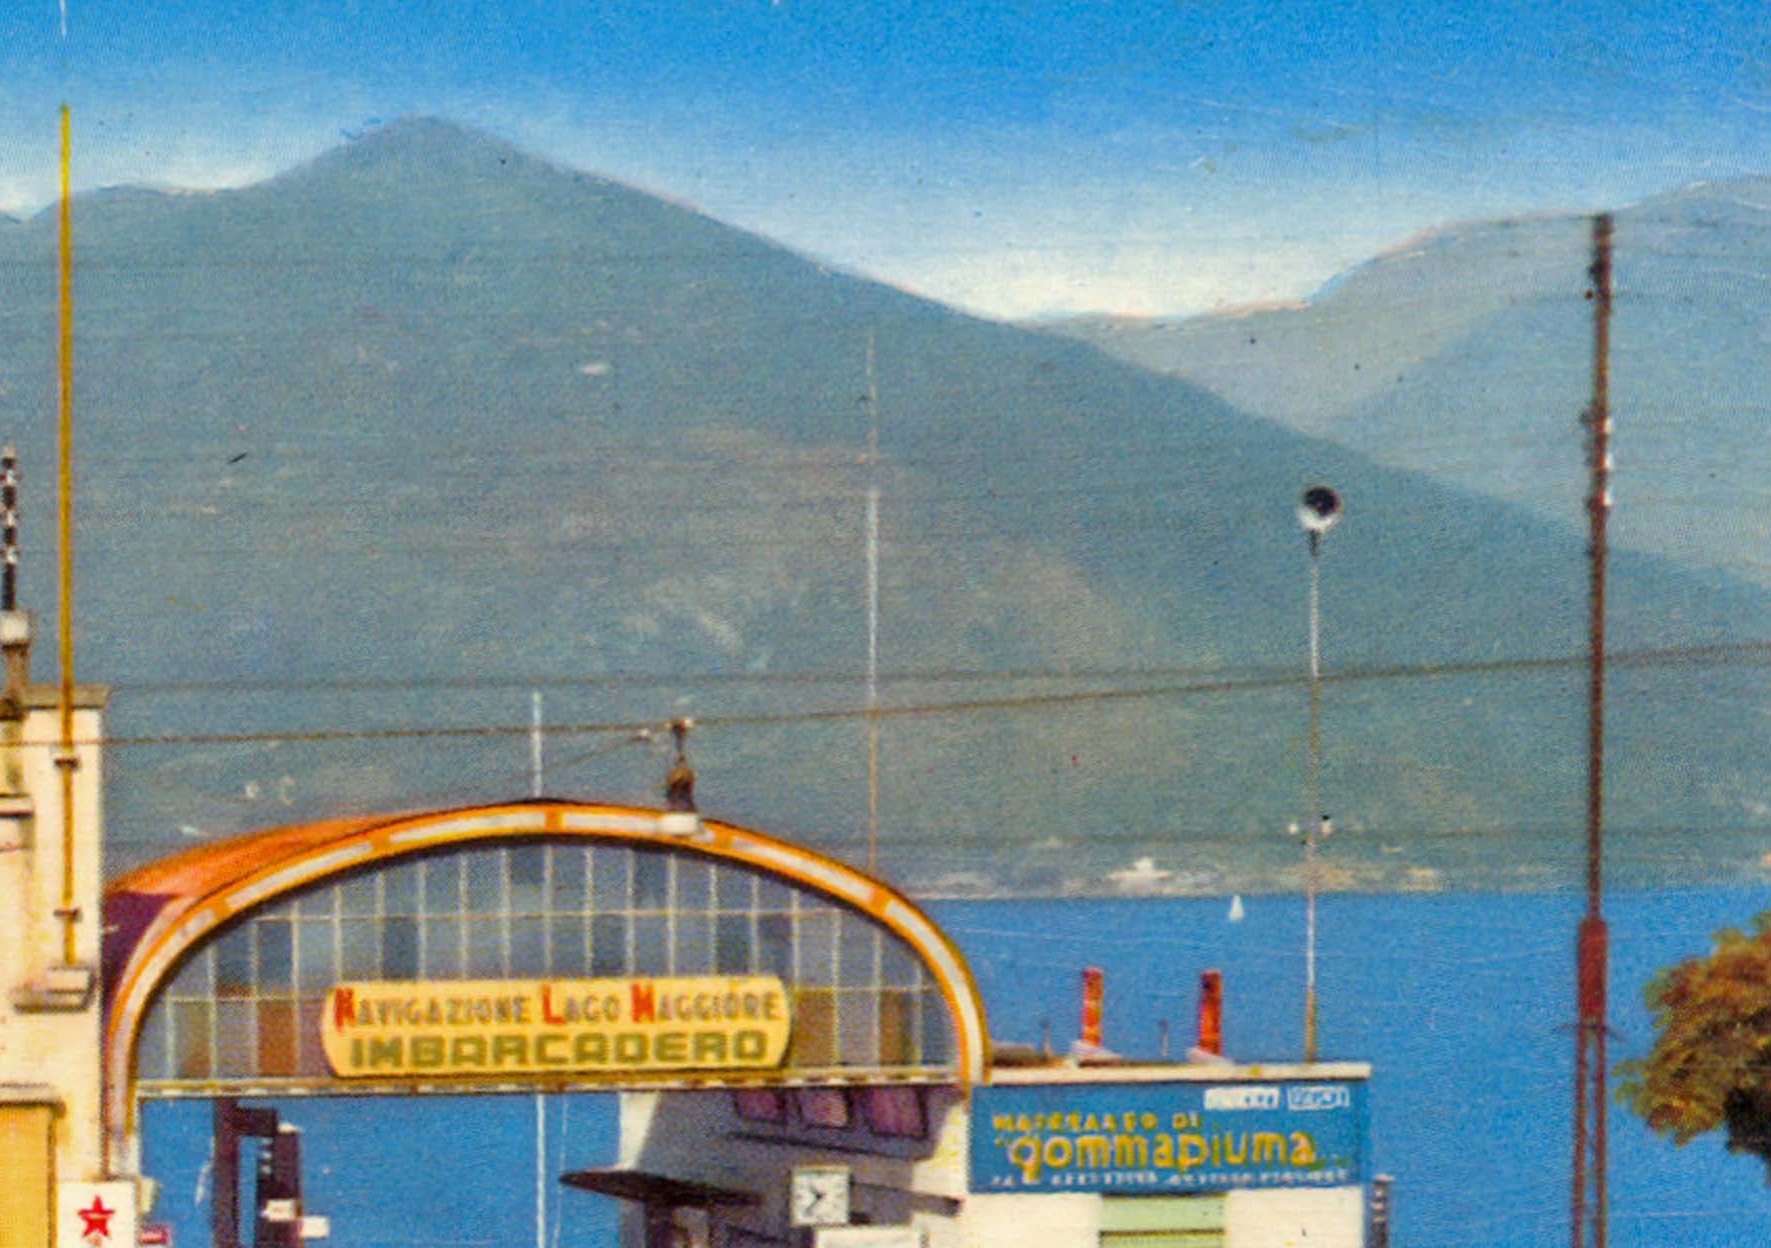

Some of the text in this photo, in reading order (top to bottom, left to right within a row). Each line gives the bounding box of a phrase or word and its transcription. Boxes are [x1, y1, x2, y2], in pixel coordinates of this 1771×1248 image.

[334, 983, 783, 1030] NAVIGAZIONE LAGO MAGGIORE
[349, 1029, 768, 1069] IMBARCADERO
[991, 1111, 1157, 1134] MATERASSO
